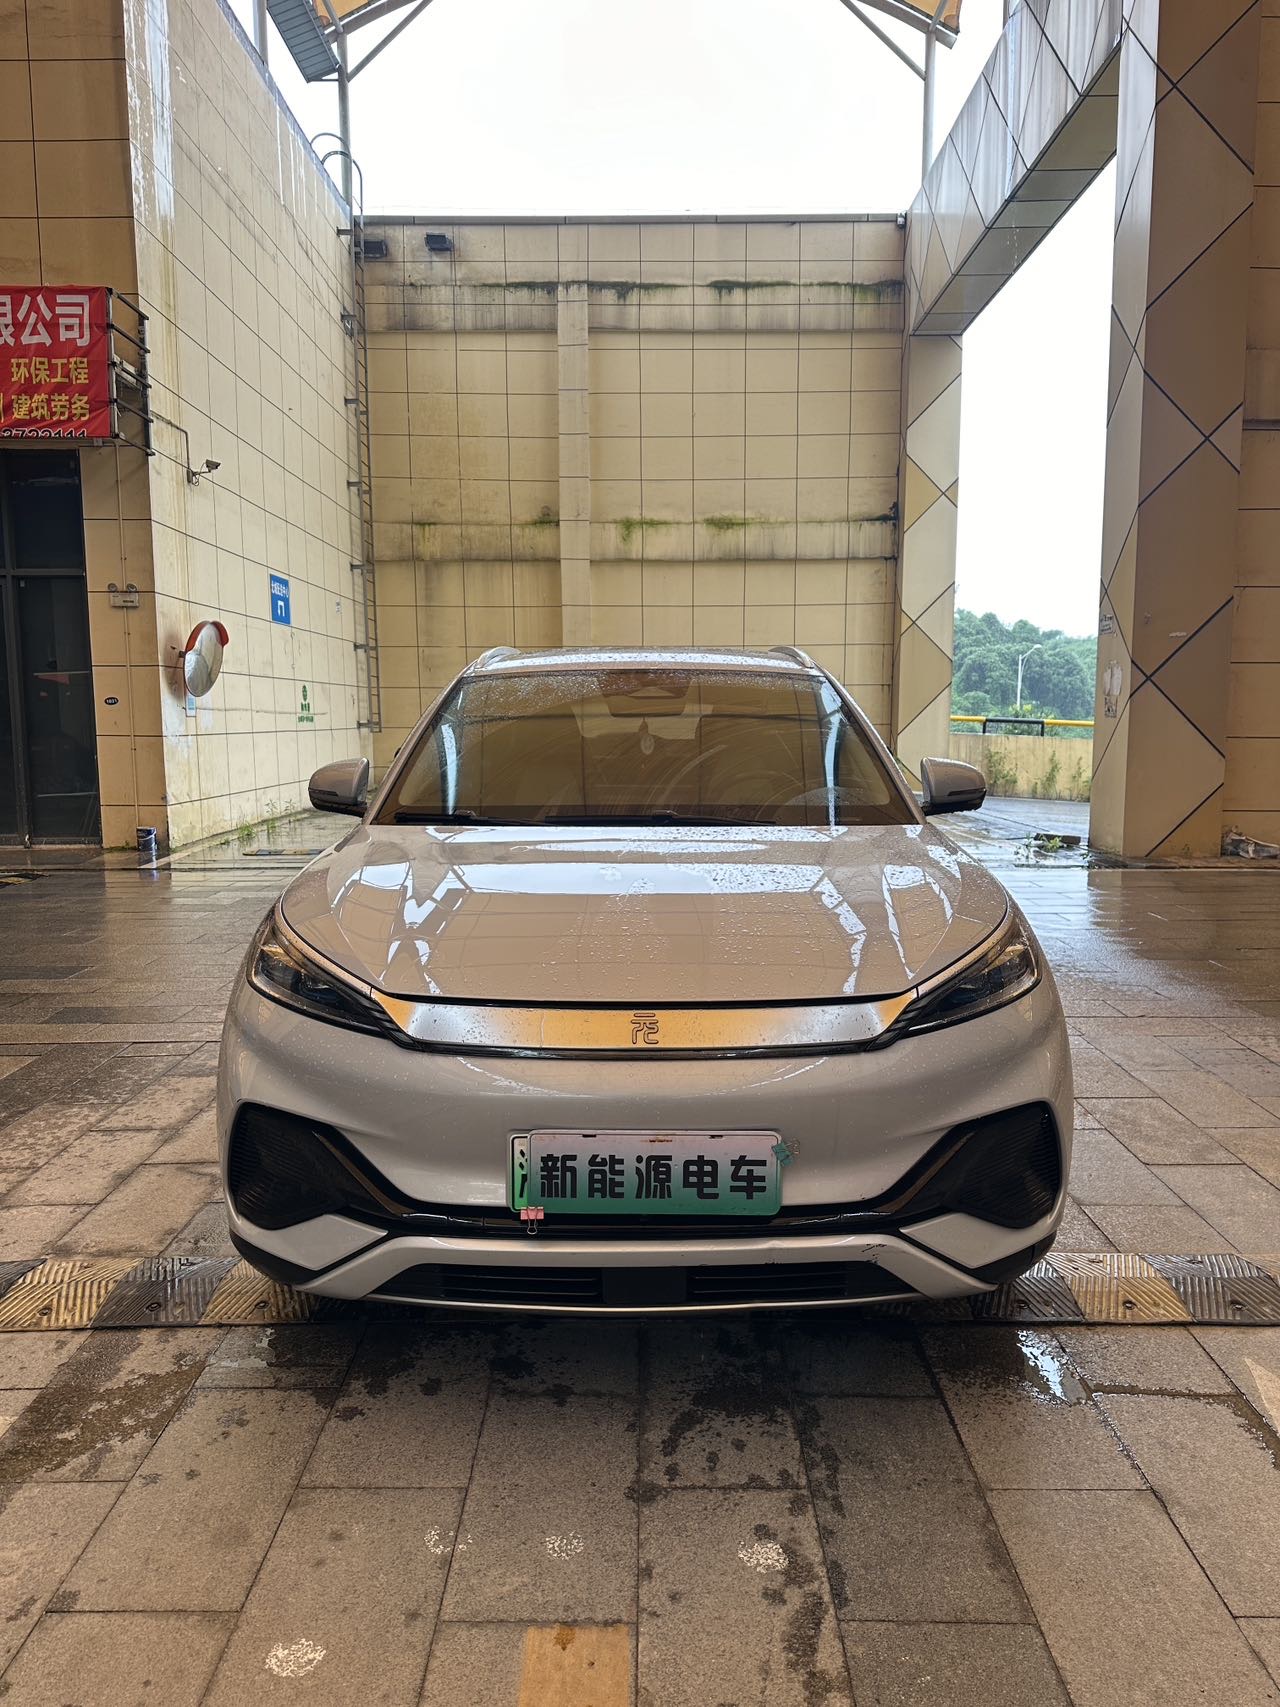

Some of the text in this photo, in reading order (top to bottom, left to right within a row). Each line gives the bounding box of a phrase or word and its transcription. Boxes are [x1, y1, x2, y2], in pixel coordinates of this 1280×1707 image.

[11, 356, 89, 384] 环保工程
[12, 393, 90, 421] 建筑劳务
[631, 1012, 659, 1045] 元
[540, 1154, 768, 1200] 新能源电车
